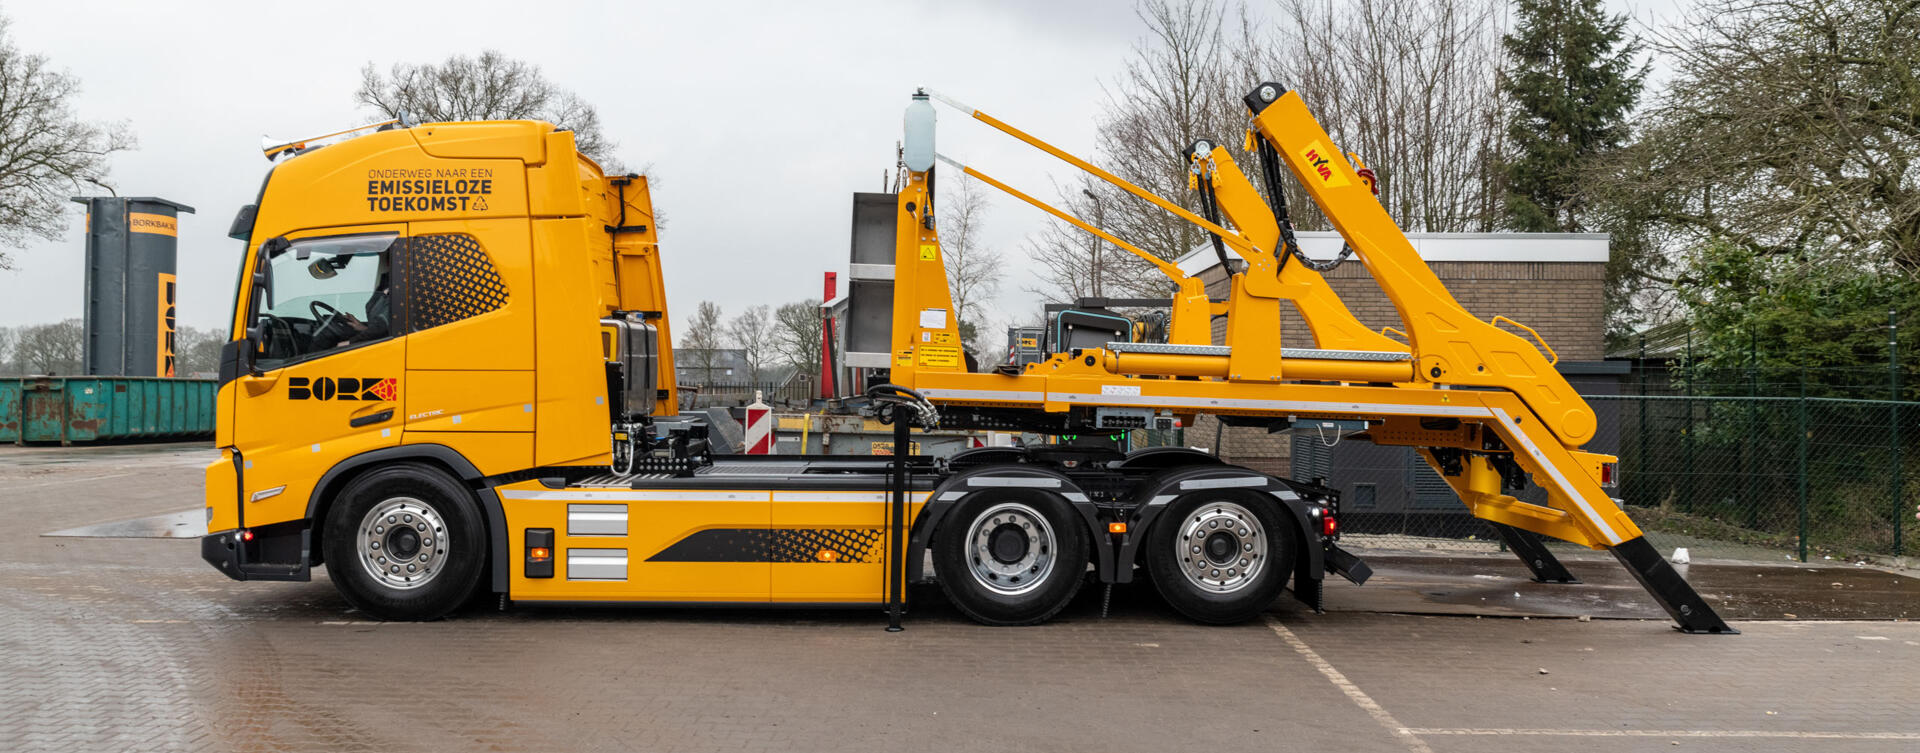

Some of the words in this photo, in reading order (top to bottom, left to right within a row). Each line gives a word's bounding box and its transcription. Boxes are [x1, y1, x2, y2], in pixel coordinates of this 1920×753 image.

[1305, 149, 1332, 182] HYVA
[368, 169, 432, 179] ONDERWEG
[436, 169, 467, 178] NAAR
[470, 168, 493, 178] EEN
[368, 180, 492, 195] EMISSIELOZE
[367, 196, 470, 212] TOEKOMST
[289, 376, 394, 401] BORK
[409, 409, 444, 420] ELECTRIC
